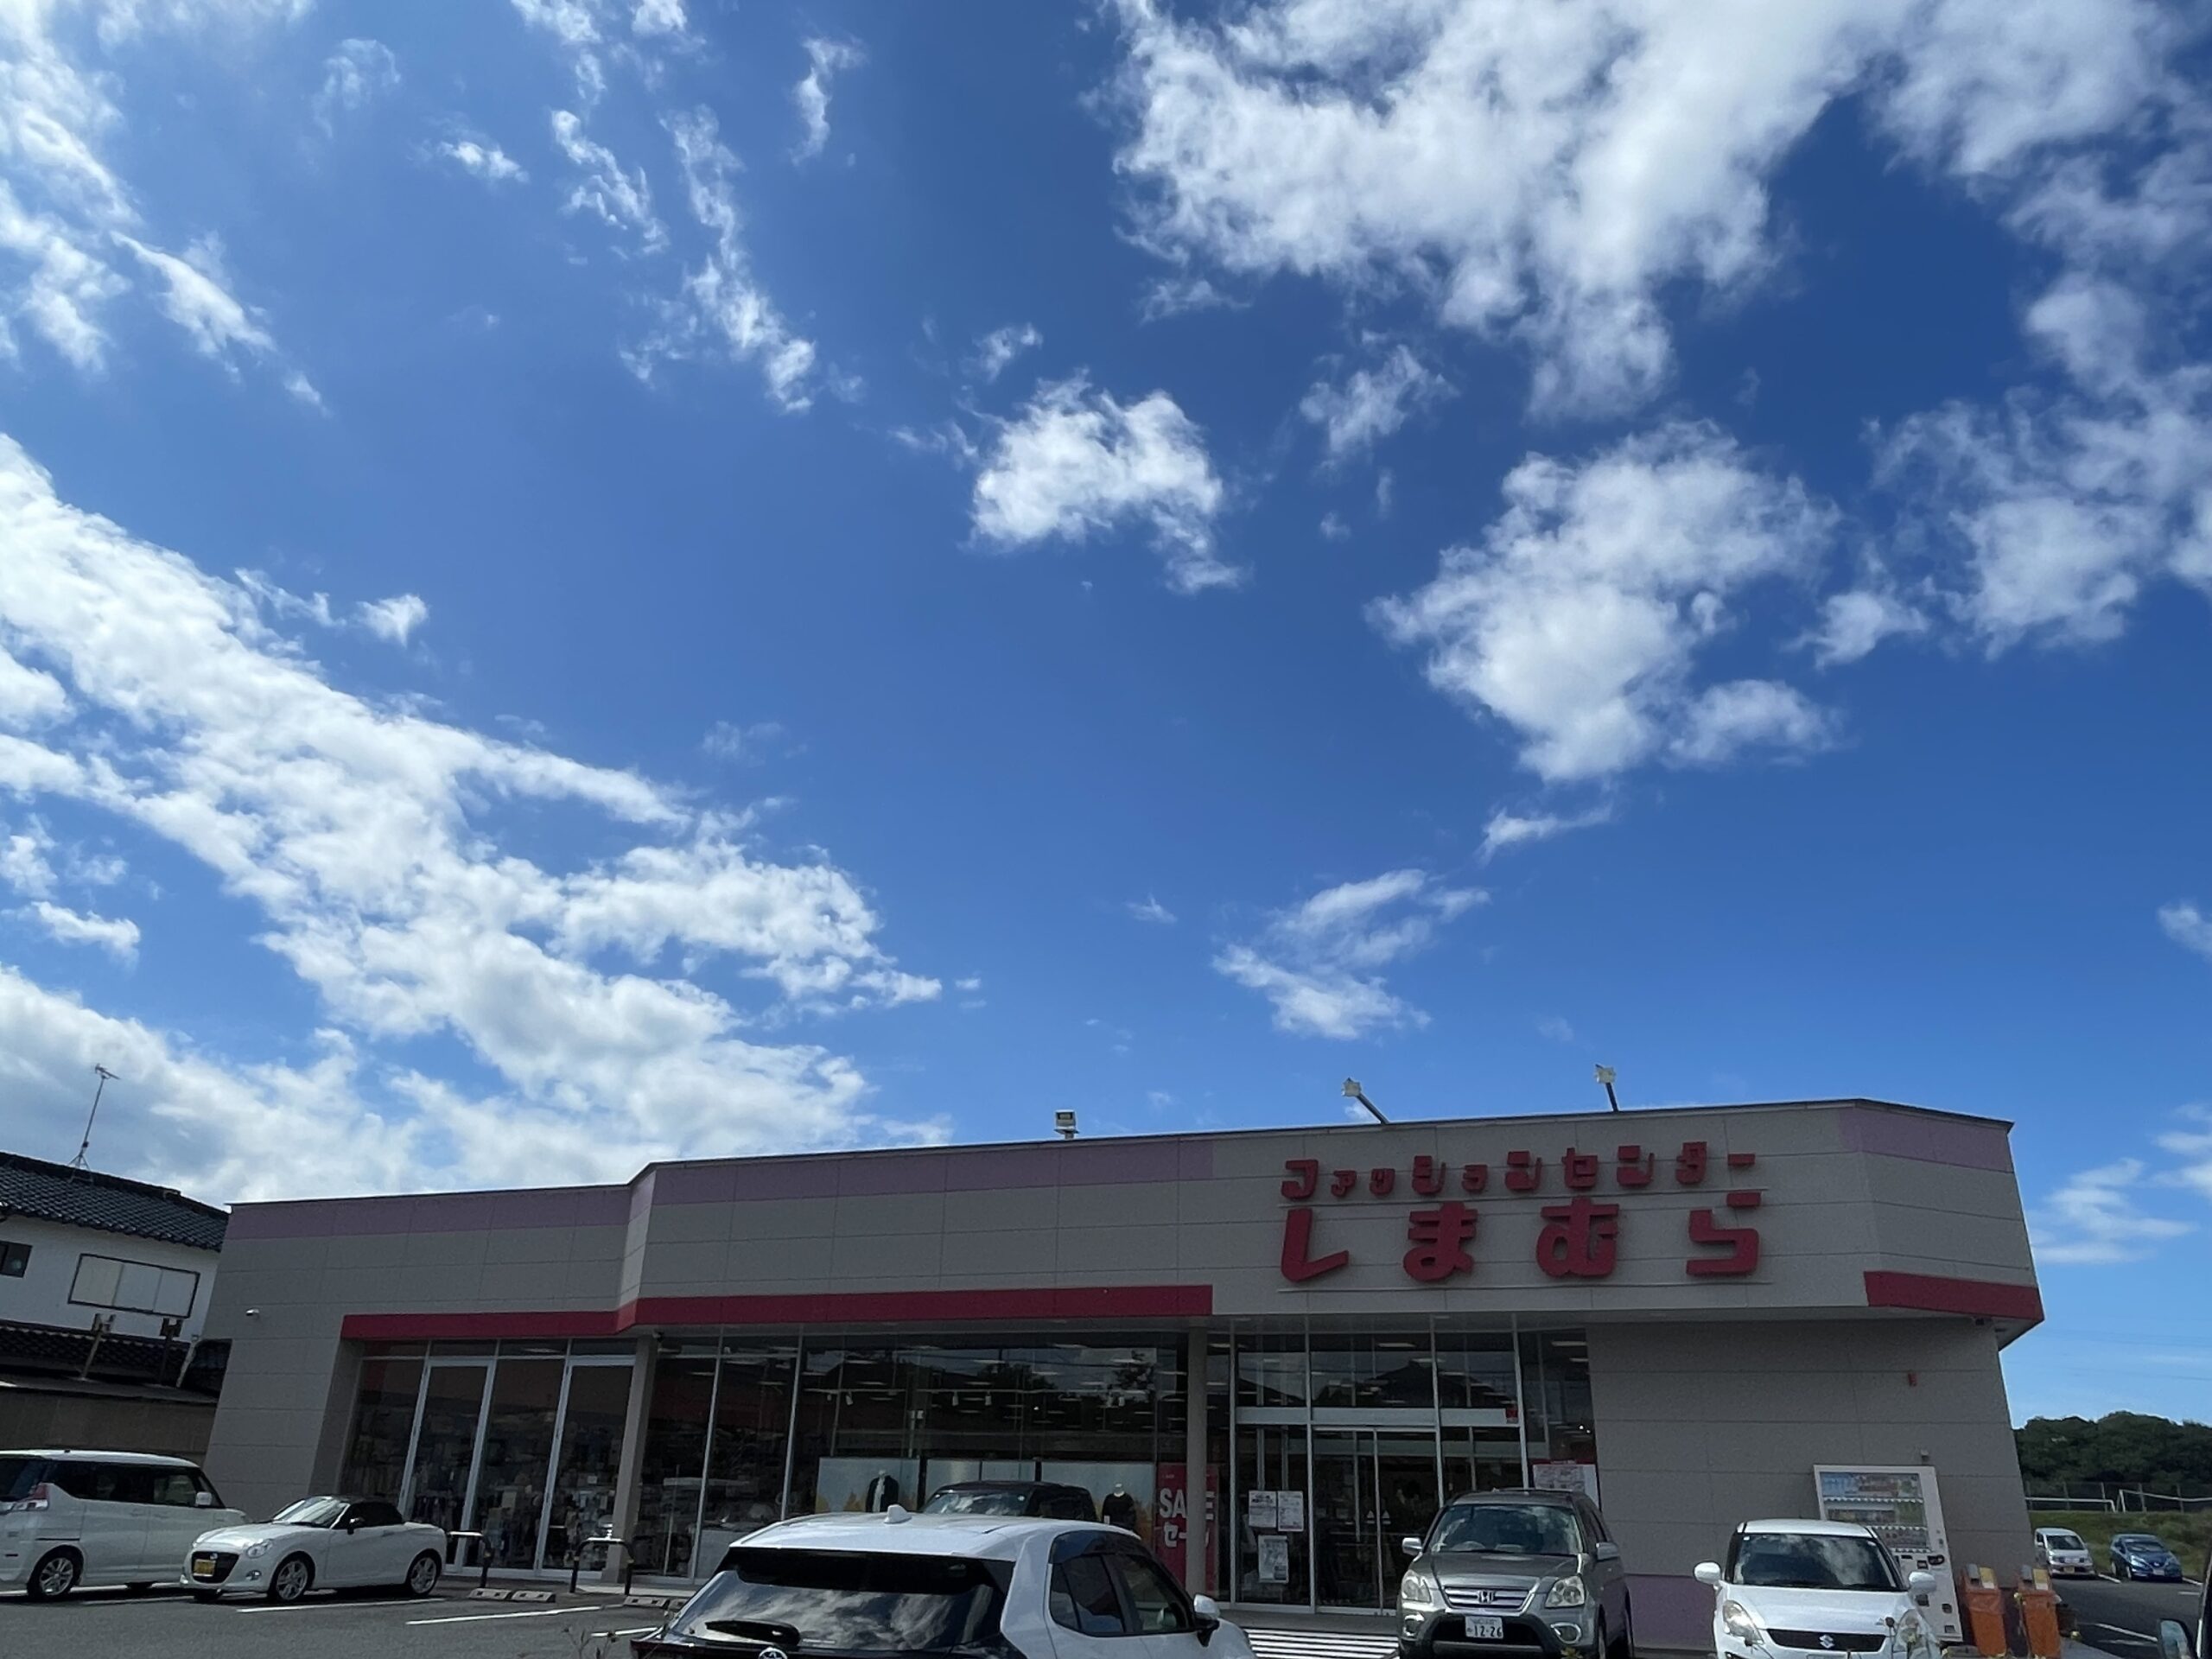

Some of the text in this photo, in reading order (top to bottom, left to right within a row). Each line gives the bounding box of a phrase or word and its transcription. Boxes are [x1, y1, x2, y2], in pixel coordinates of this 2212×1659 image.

[1281, 1141, 1756, 1200] ファッションセンター
[1281, 1192, 1762, 1282] しまむら
[1160, 1488, 1215, 1520] SAE
[1164, 1522, 1210, 1548] セー
